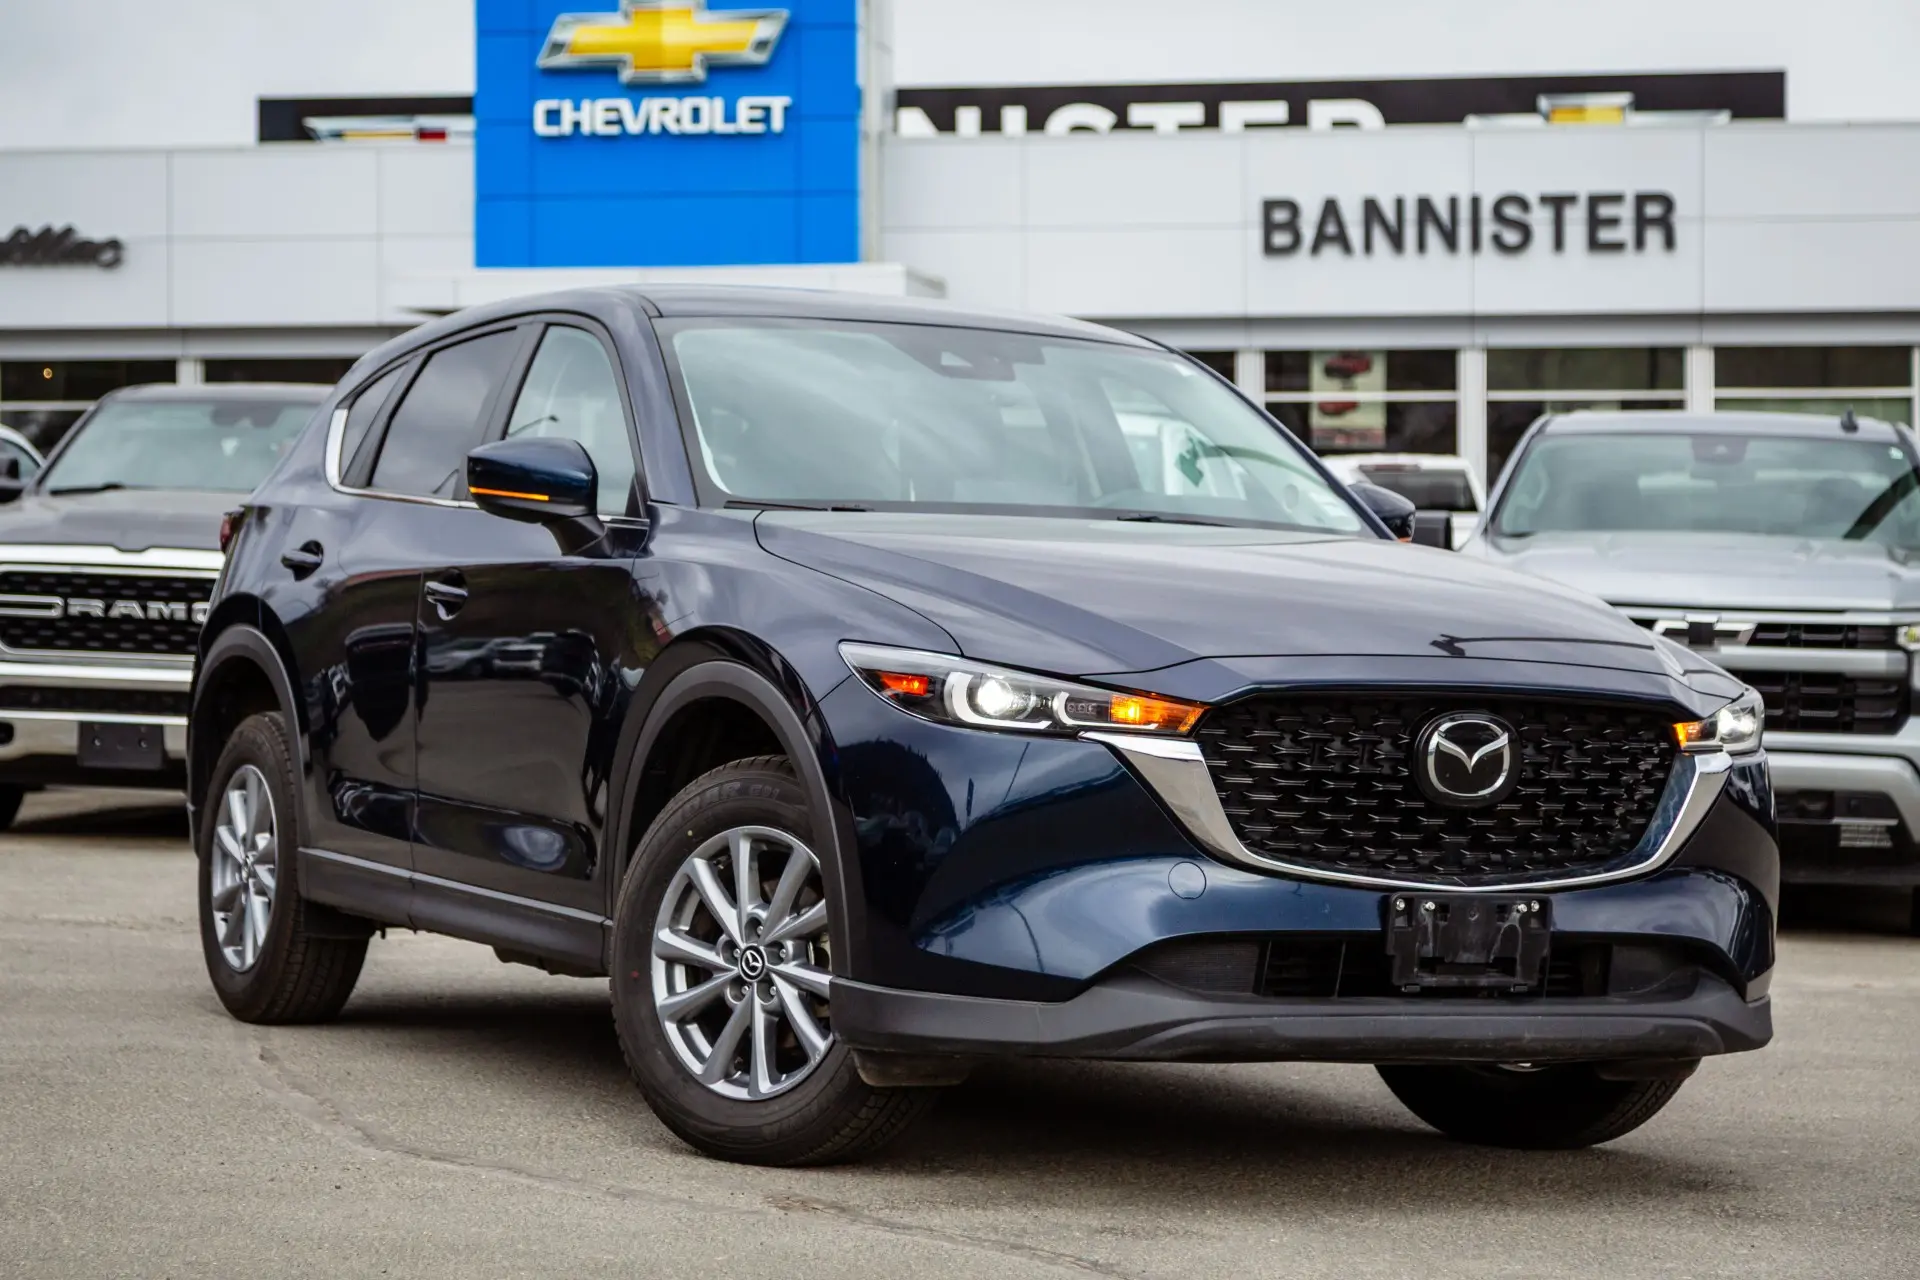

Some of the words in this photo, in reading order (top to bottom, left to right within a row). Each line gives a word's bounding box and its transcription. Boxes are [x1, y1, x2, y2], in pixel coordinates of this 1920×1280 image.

[533, 96, 792, 136] CHEVROLET
[1262, 193, 1677, 257] BANNISTER
[66, 597, 188, 621] RAM
